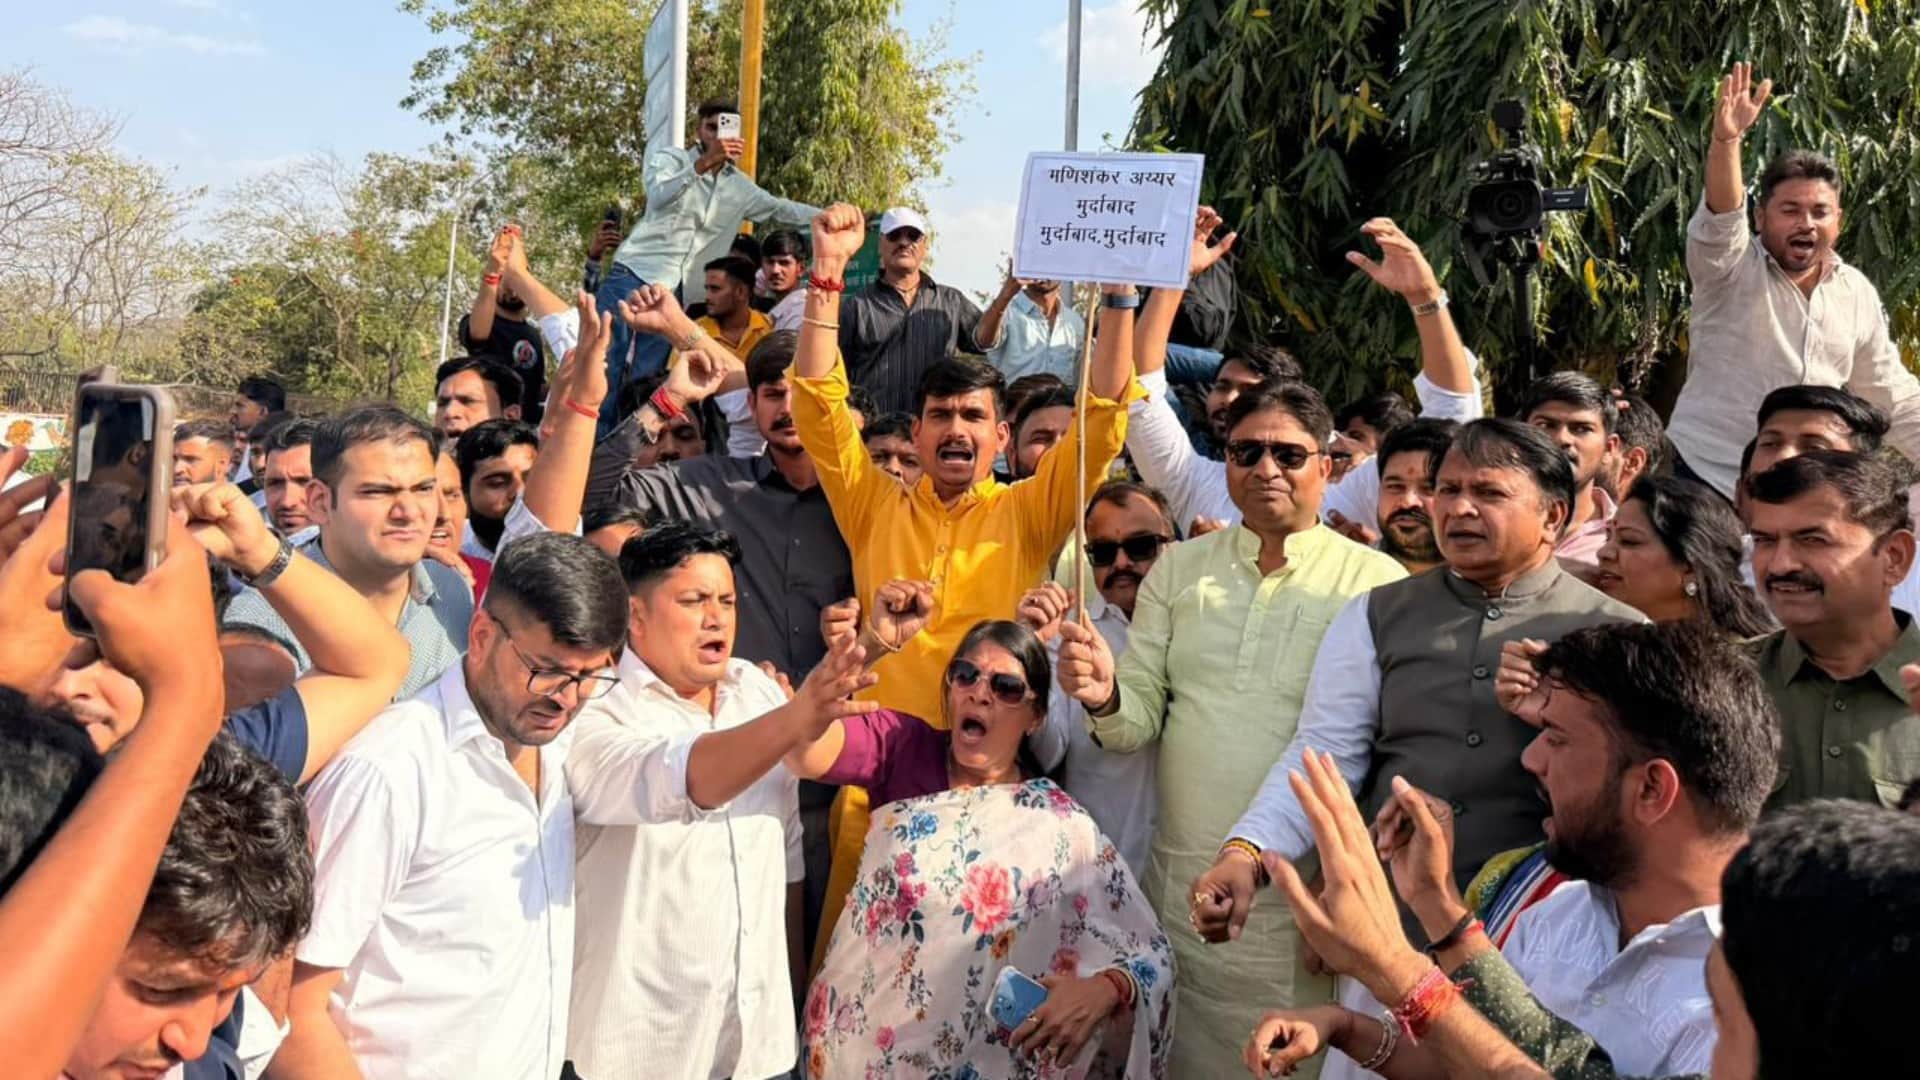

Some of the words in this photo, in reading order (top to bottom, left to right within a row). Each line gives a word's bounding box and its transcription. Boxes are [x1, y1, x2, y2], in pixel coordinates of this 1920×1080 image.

[1049, 165, 1120, 185] मणिशंकर
[1129, 171, 1176, 187] अय्यर
[1076, 194, 1137, 218] मुर्दाबाद
